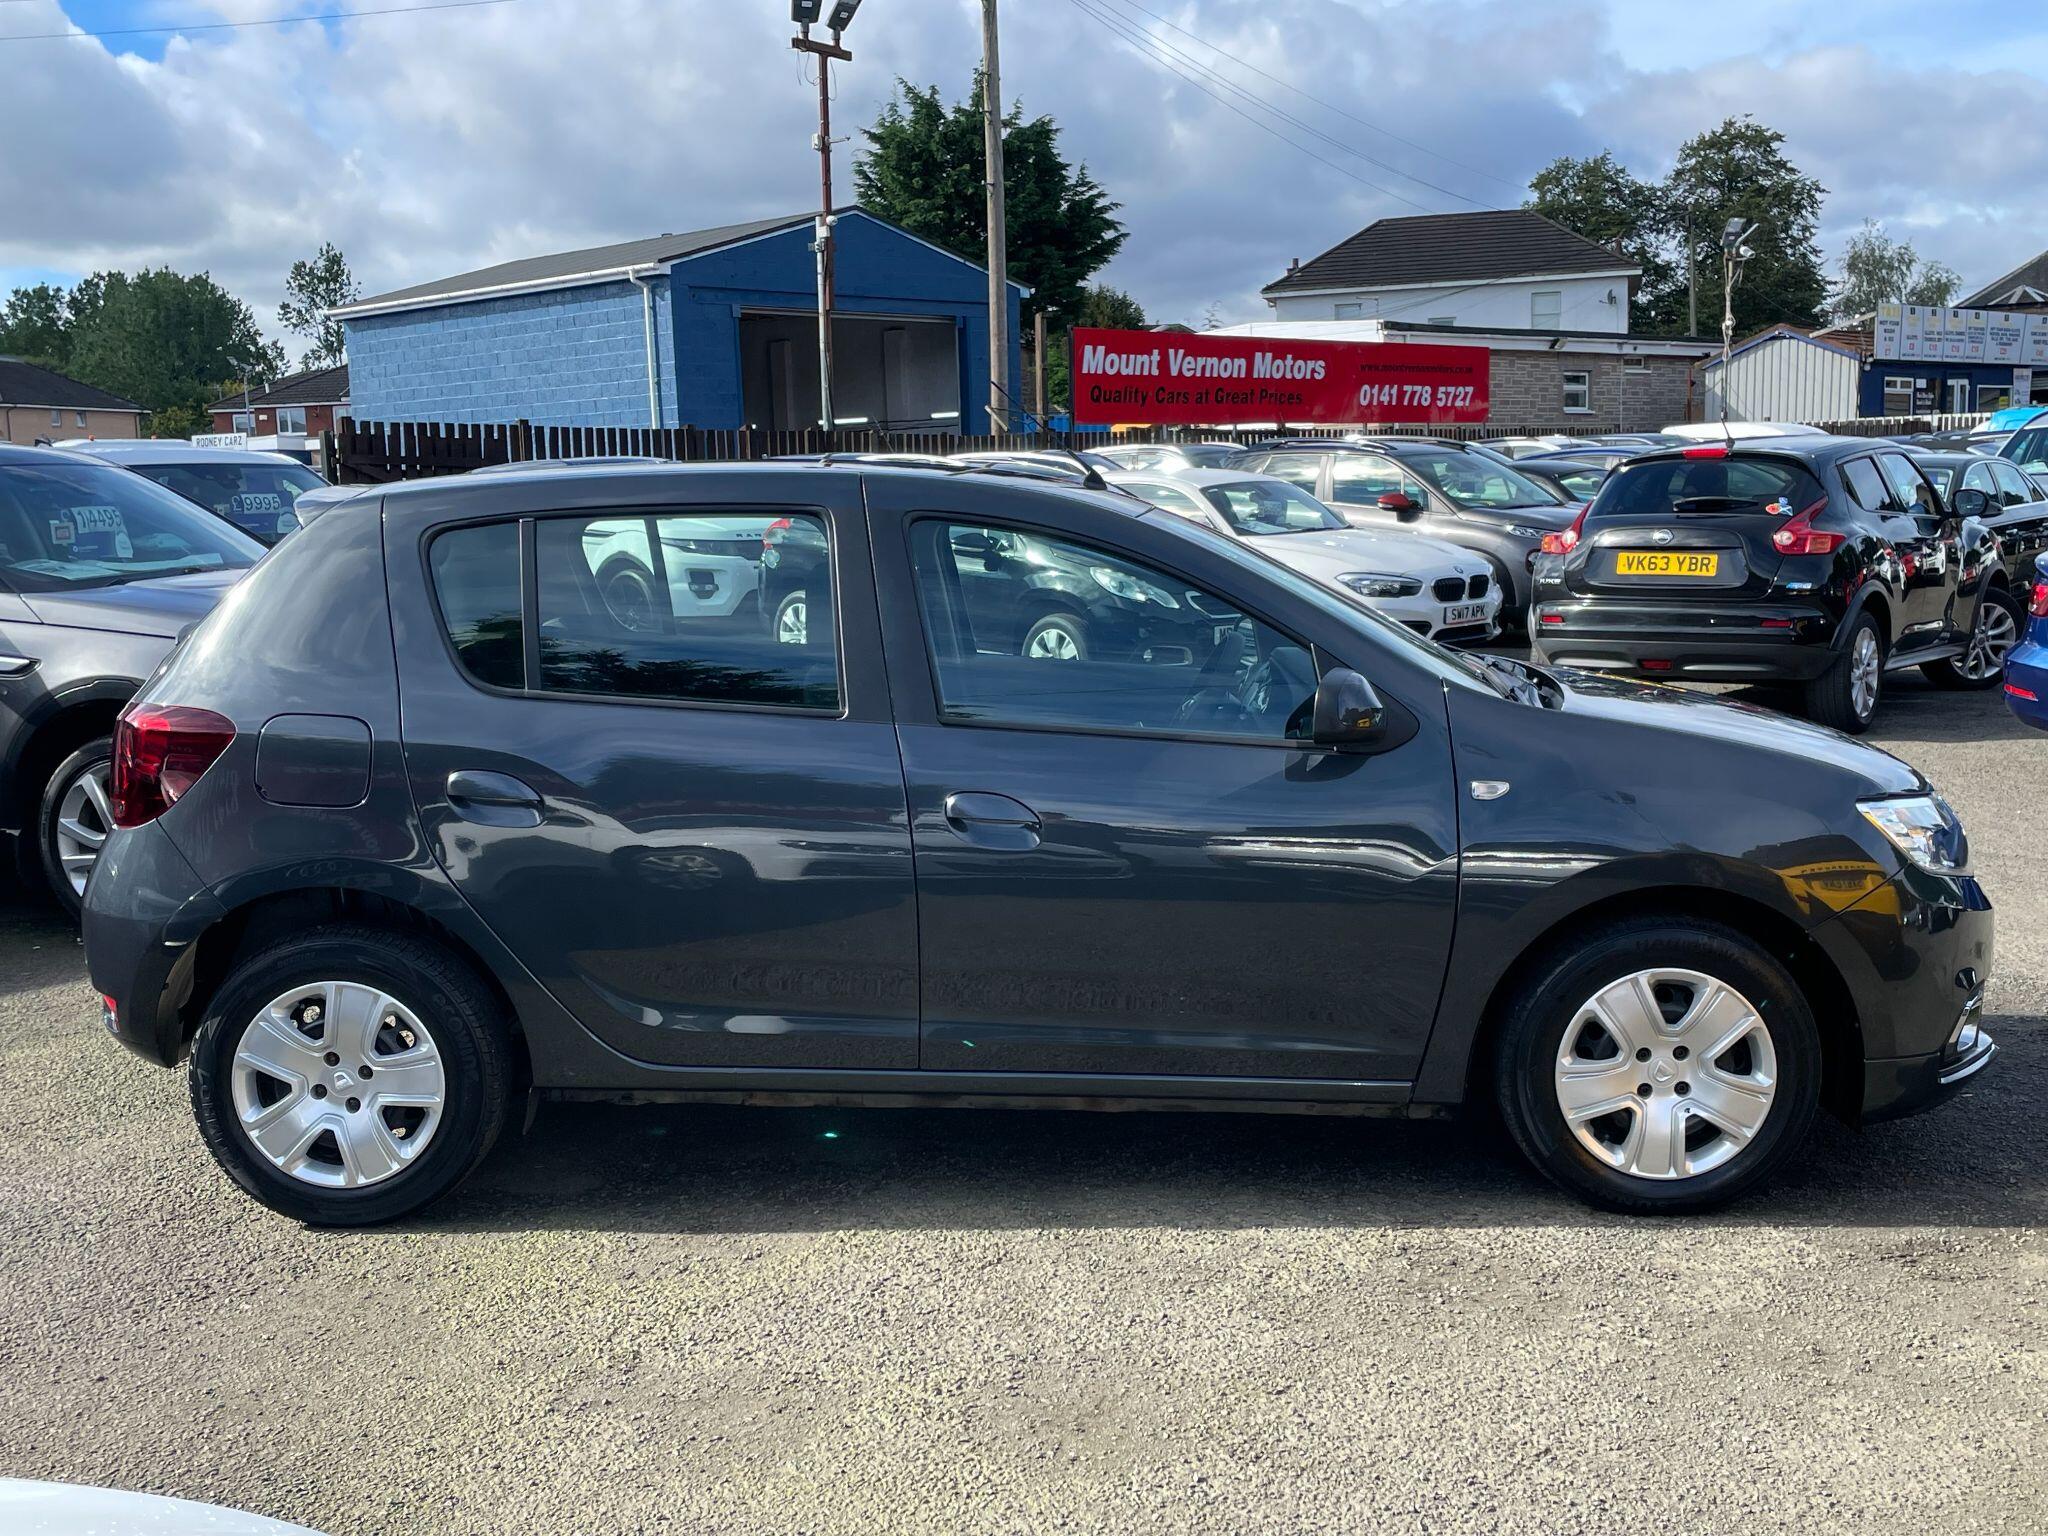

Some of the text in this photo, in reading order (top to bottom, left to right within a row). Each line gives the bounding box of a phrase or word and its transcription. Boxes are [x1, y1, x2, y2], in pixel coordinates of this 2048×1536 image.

[1081, 345, 1326, 380] Mount Vernon Motors
[1090, 385, 1304, 407] Quality Cars at Great Prices
[1360, 384, 1474, 407] 0141 778 5727
[1625, 555, 1711, 573] VK63 YBR
[1451, 604, 1486, 620] SW17 APK
